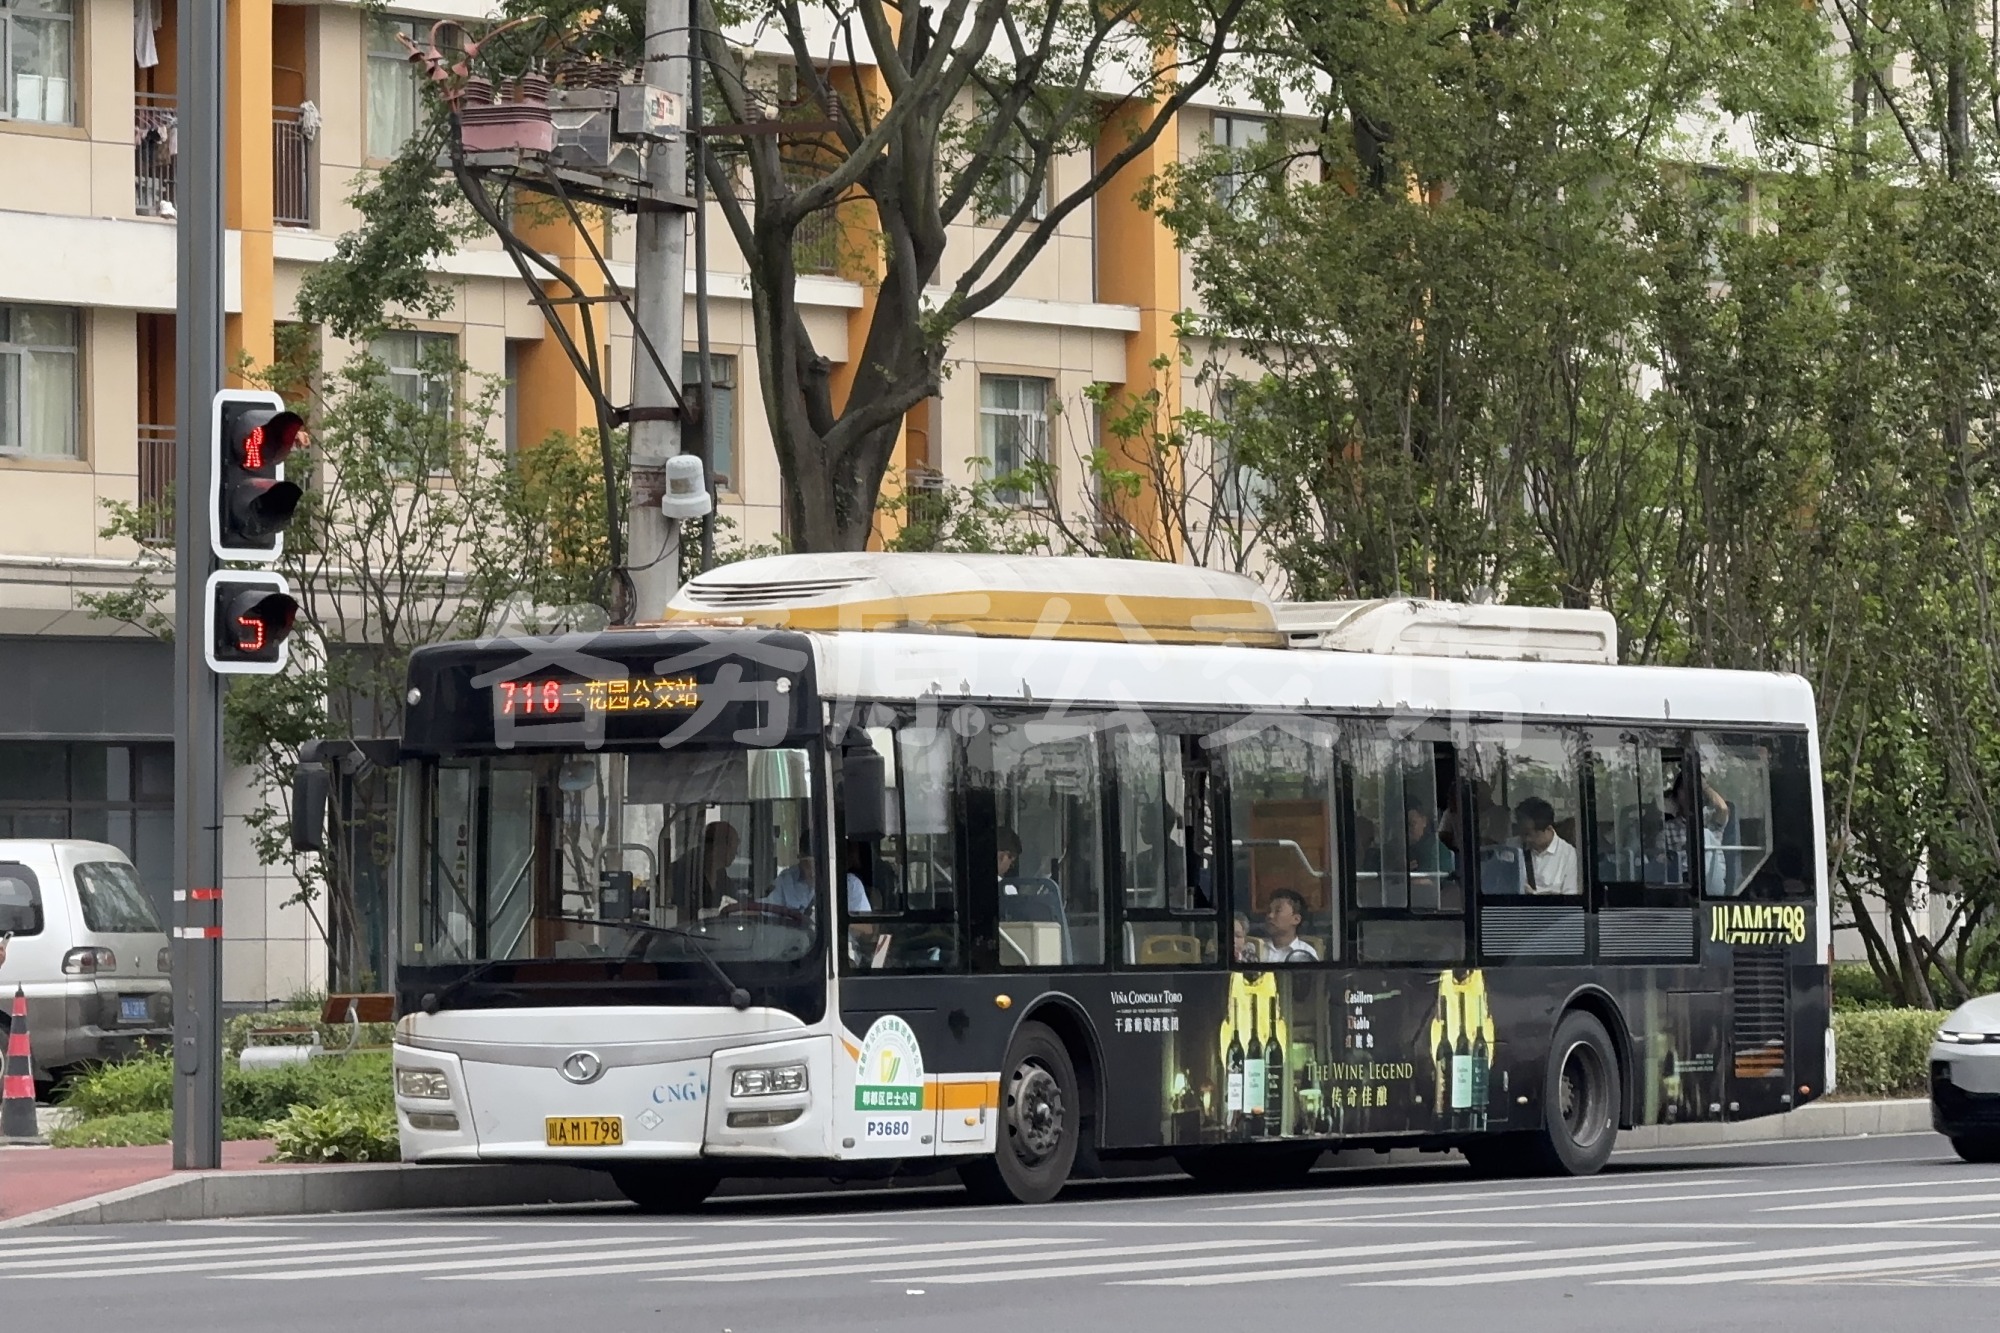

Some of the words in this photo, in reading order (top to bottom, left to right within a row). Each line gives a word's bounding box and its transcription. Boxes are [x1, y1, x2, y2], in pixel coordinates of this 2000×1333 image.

[499, 681, 561, 714] 716
[584, 677, 698, 712] 花园公交站
[1711, 905, 1806, 944] 川AM1798
[652, 1082, 697, 1104] CNG
[862, 1091, 917, 1107] 郫都区巴士公司
[1332, 1085, 1388, 1108] 传奇佳酿
[867, 1121, 909, 1136] P3680
